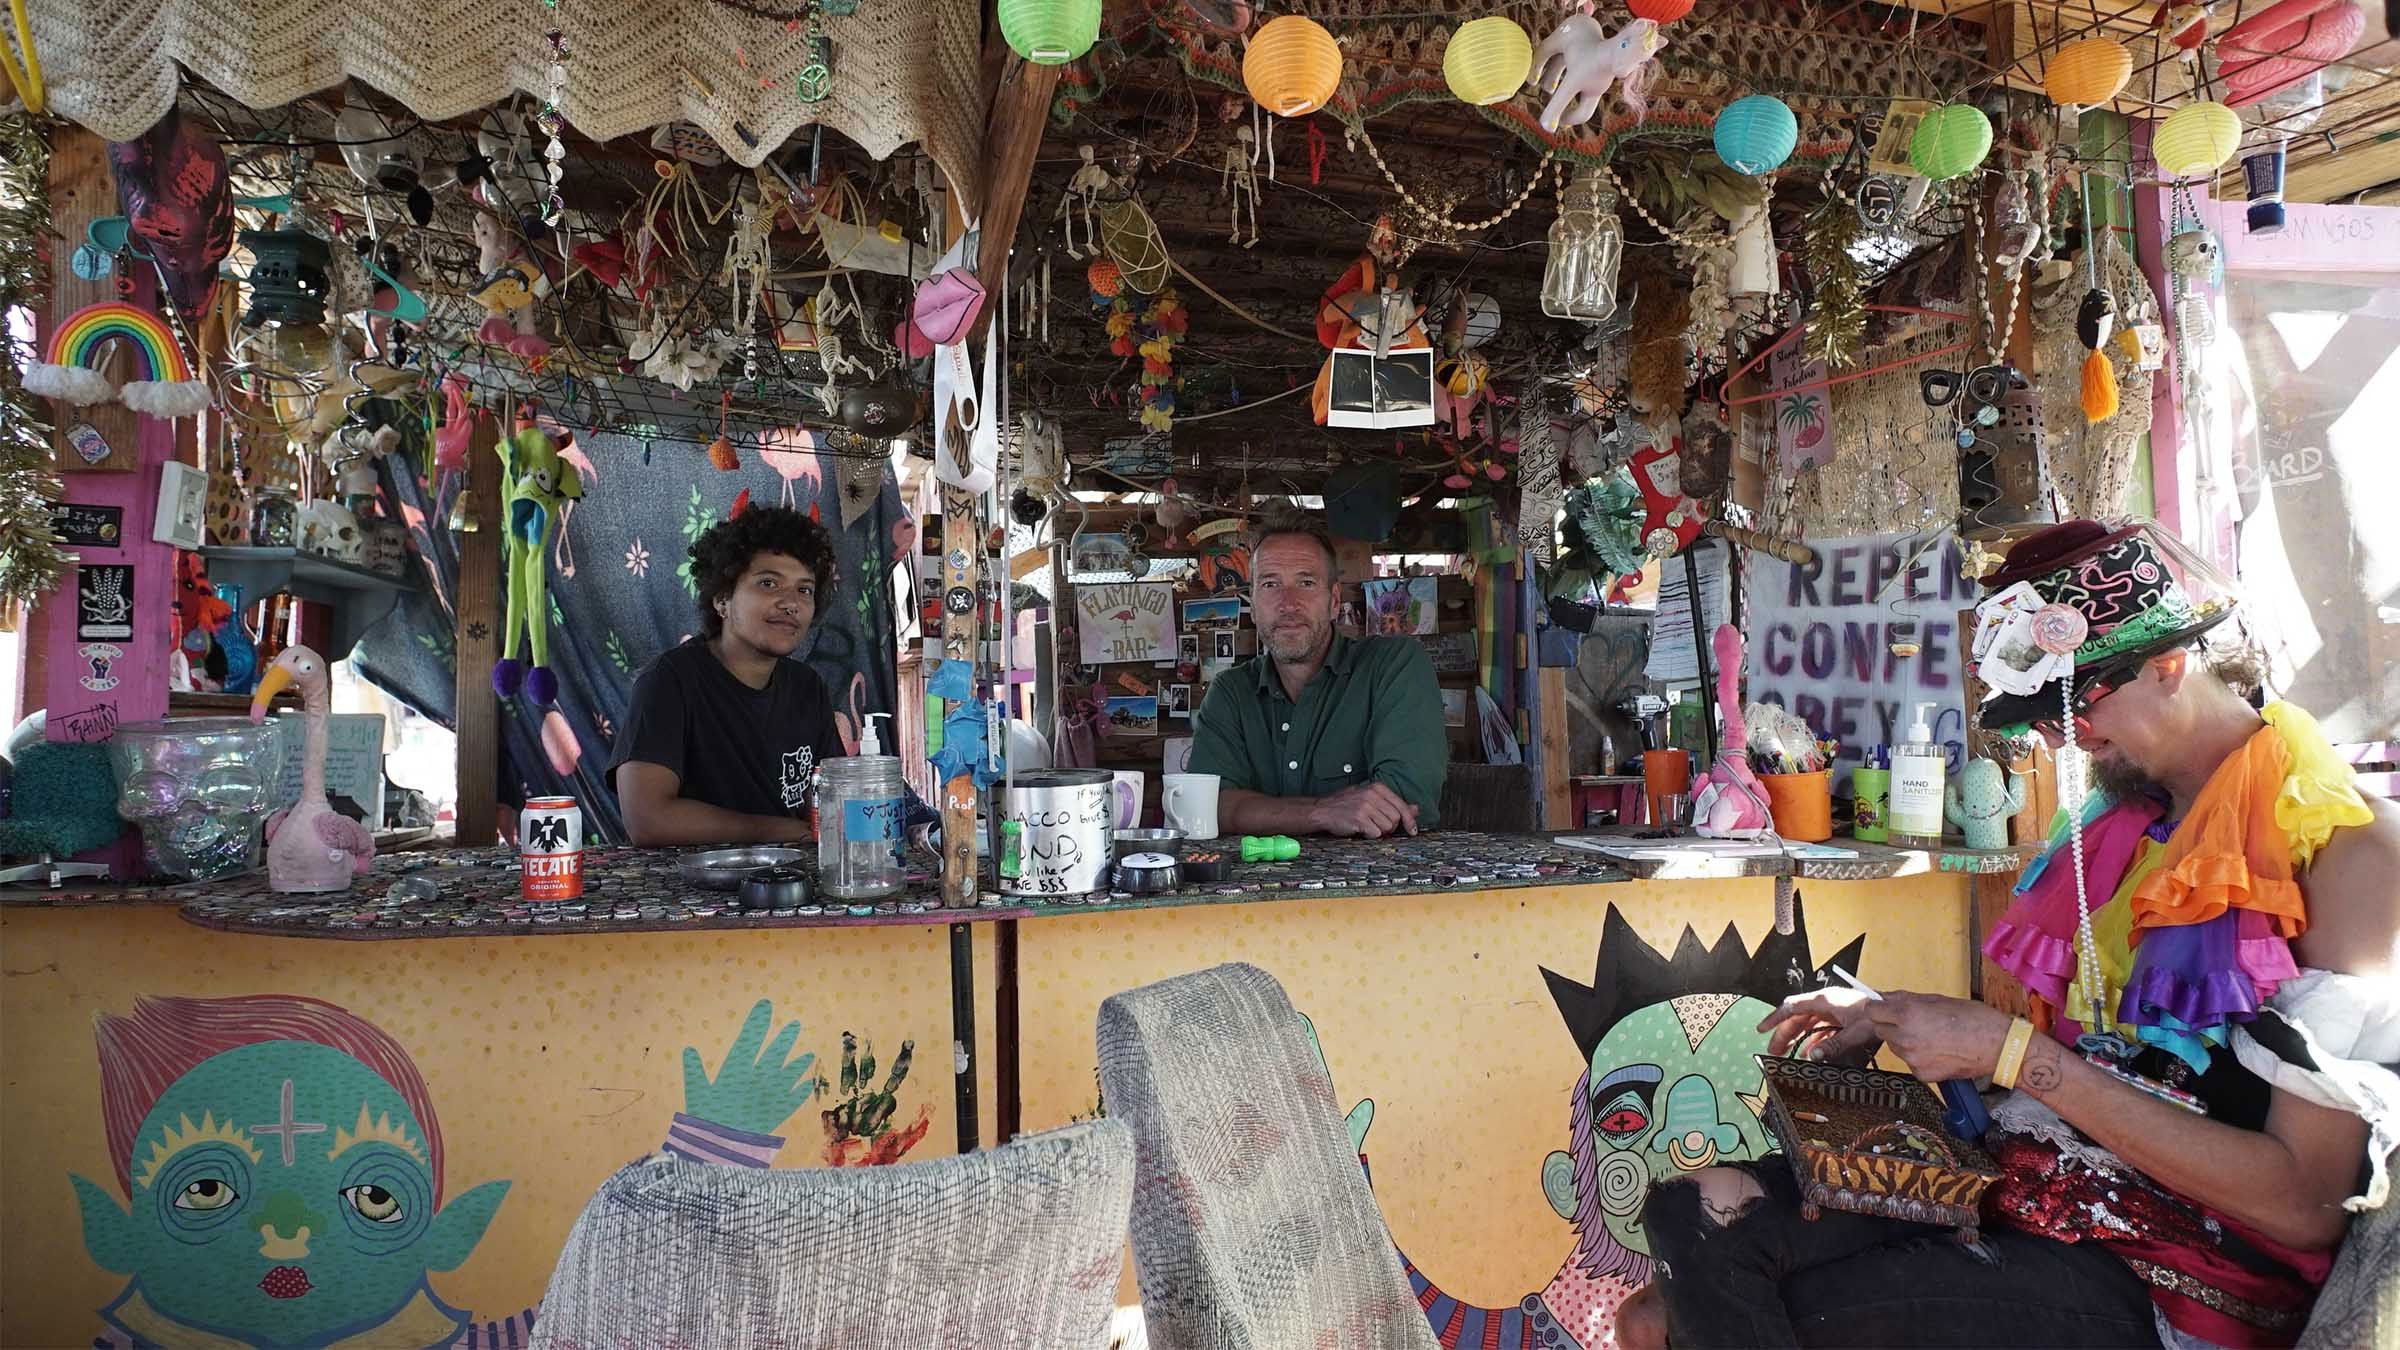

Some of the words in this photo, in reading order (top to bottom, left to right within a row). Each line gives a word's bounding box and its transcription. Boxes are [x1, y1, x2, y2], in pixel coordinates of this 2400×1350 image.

[1080, 584, 1168, 619] FLAMINGO
[1112, 638, 1148, 660] BAR
[1902, 780, 1929, 788] HAND
[1902, 788, 1942, 796] SANITI
[1018, 834, 1078, 861] ND
[522, 855, 578, 877] TECATE
[530, 883, 569, 891] ORIGINAL
